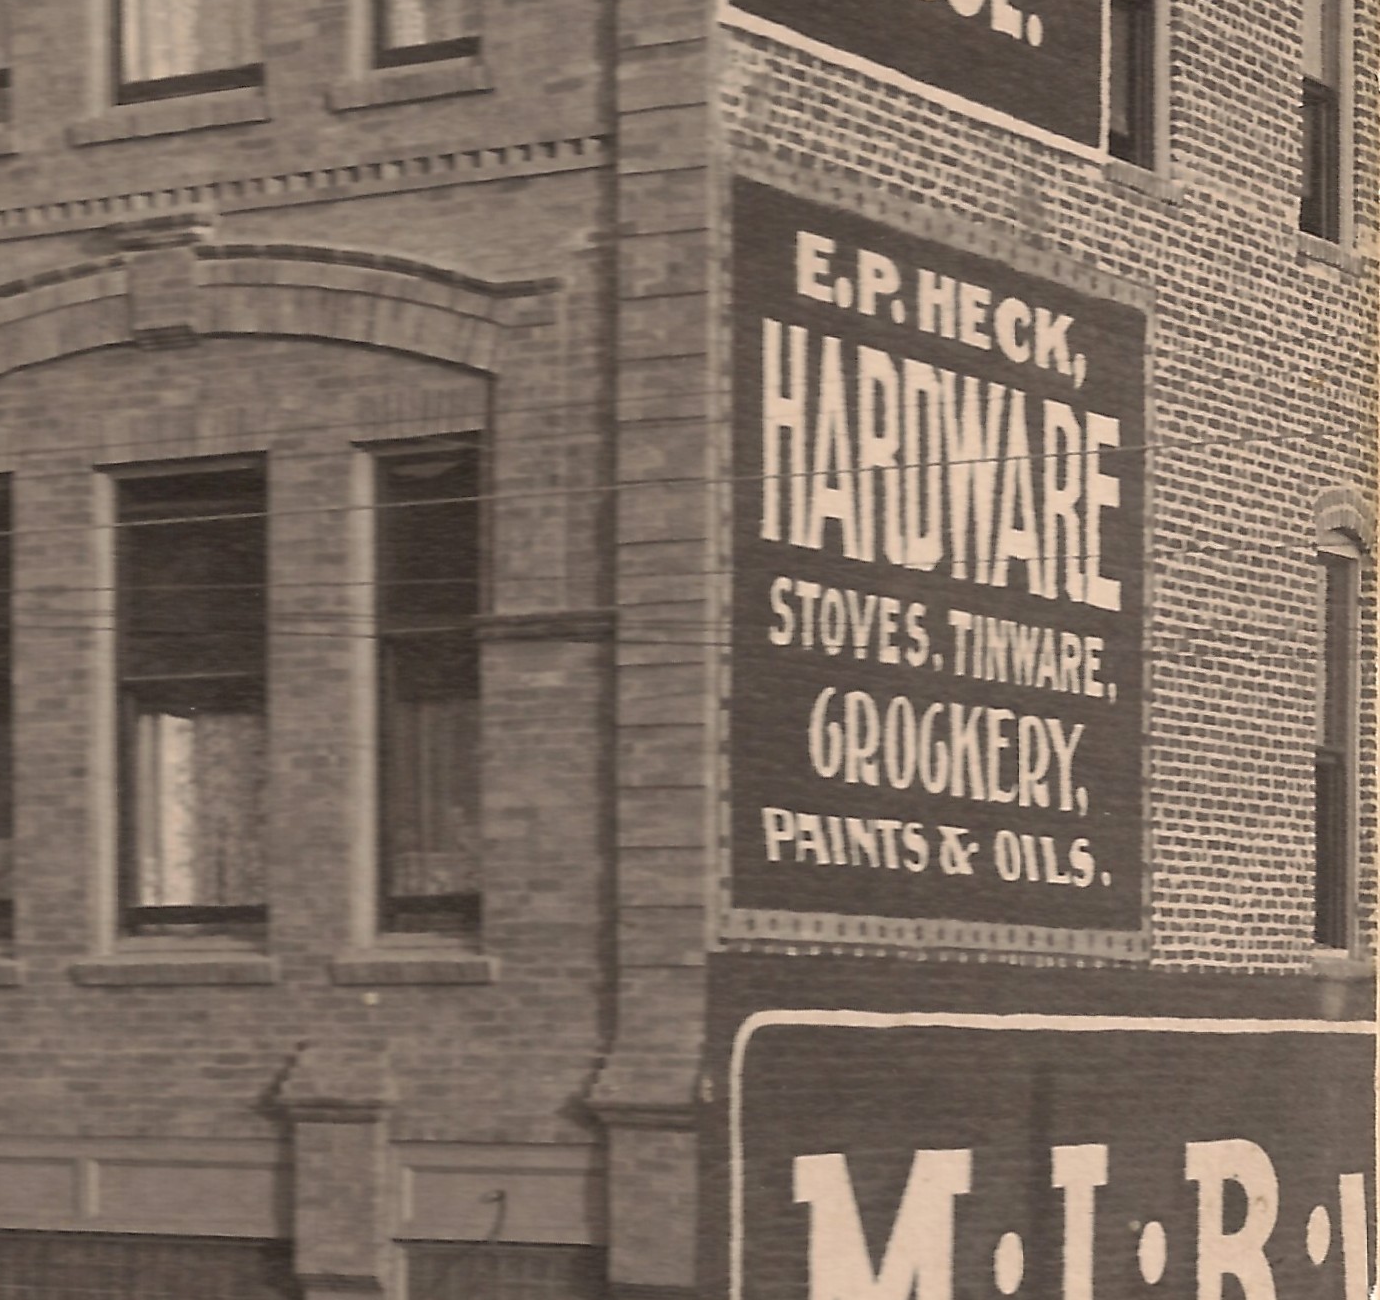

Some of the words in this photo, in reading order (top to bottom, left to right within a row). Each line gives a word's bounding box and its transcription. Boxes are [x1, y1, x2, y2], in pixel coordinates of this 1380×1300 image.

[917, 268, 1087, 389] HECK,
[762, 318, 1122, 612] HARDWARE
[948, 609, 1117, 703] TINWARE,
[762, 807, 929, 873] PAINTS
[938, 825, 979, 875] &
[994, 829, 1111, 888] OILS.
